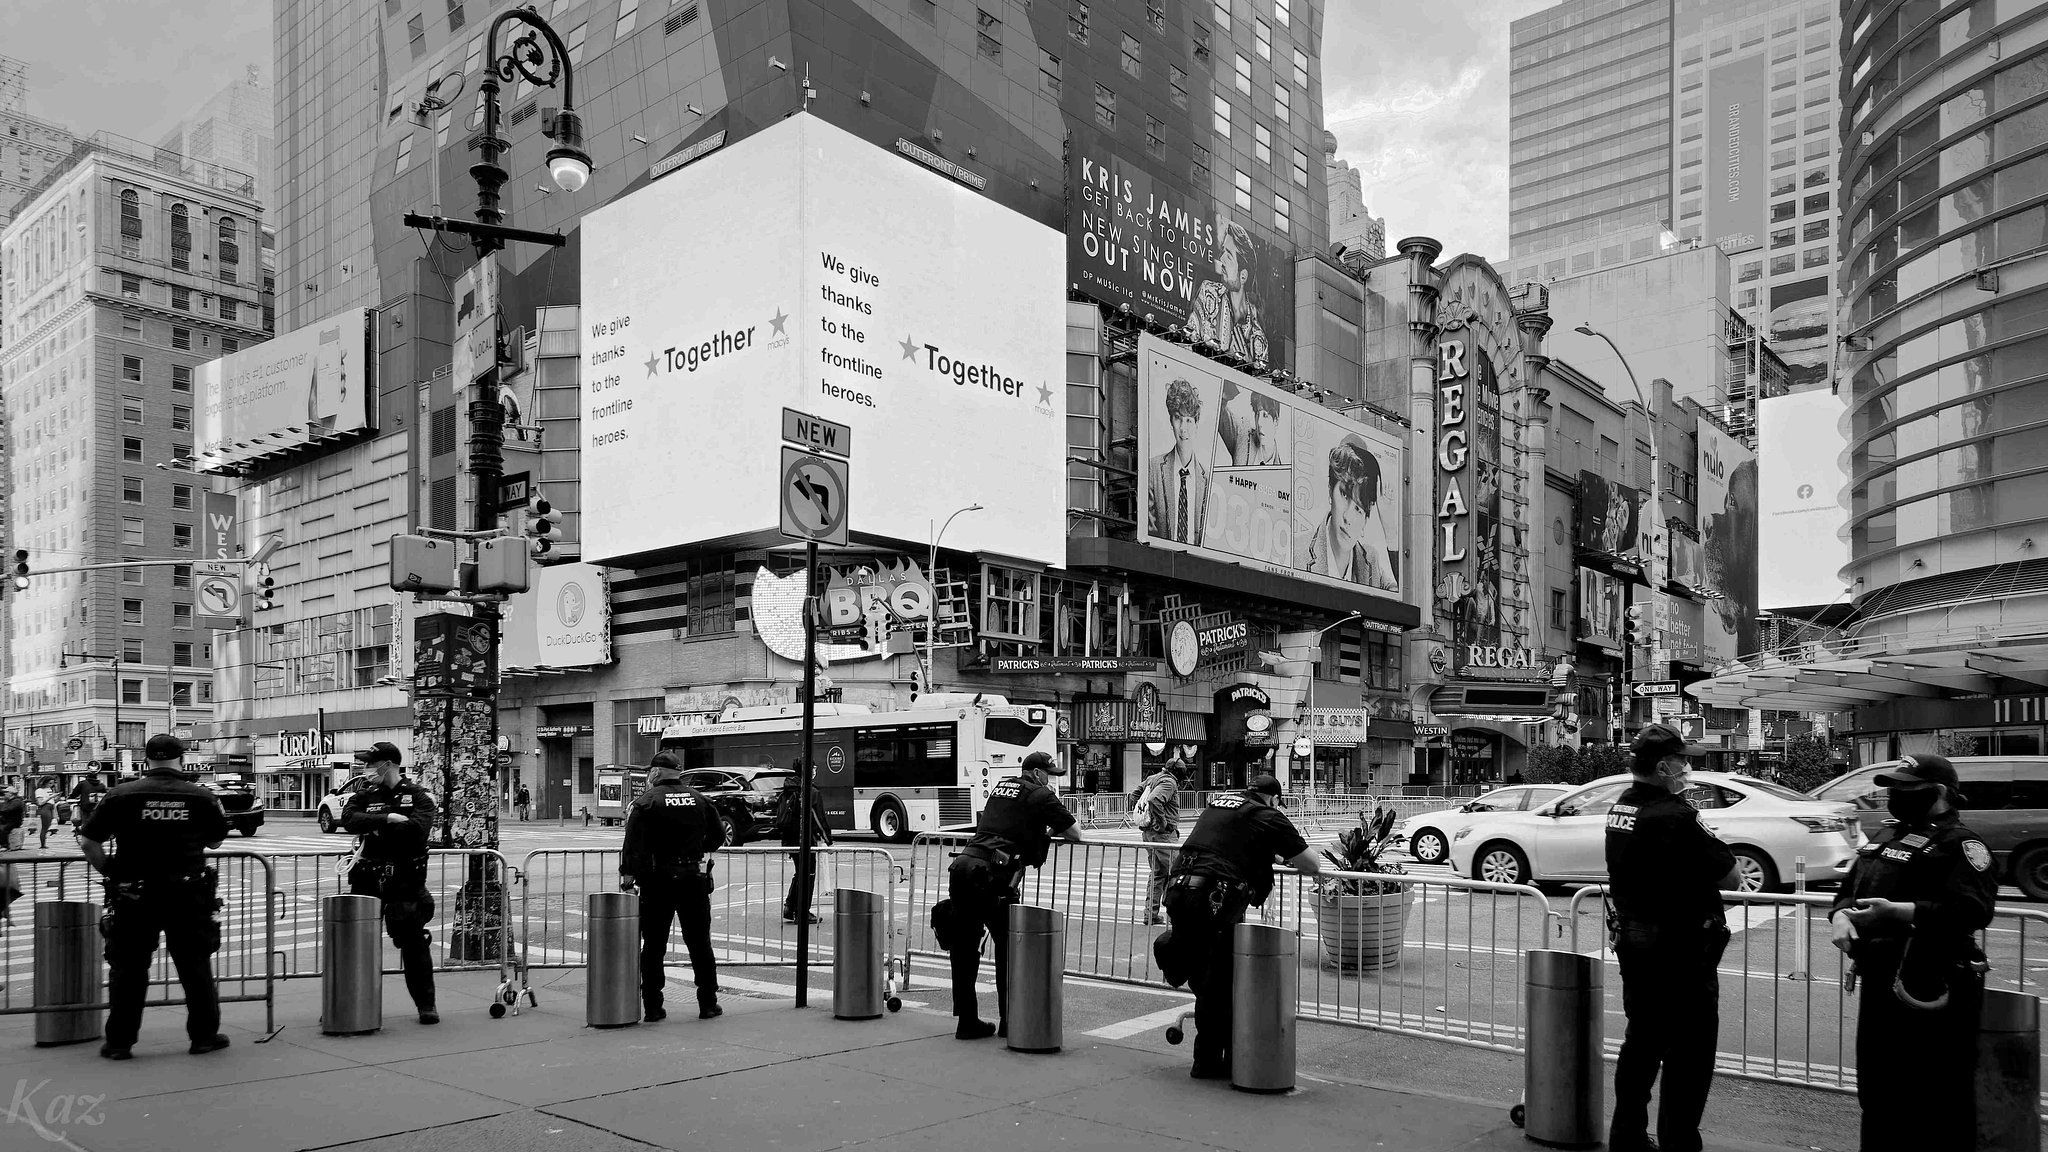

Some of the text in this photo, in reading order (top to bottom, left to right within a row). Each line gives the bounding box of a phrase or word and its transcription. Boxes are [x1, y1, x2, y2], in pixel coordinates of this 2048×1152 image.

[651, 134, 723, 177] OUTFRONT PRIME
[1728, 103, 1741, 202] BRANDEDCITIES.COM
[901, 141, 984, 190] OUTFRONT PRIME
[1082, 157, 1213, 246] KRIS JAMES
[1082, 186, 1213, 264] GET BACK TO LOVE
[1082, 210, 1194, 280] NEW SINGLE
[821, 251, 880, 287] We give
[1083, 231, 1193, 301] OUT NOW
[1083, 270, 1093, 280] DP
[821, 284, 873, 315] thanks
[592, 315, 631, 338] We give
[821, 316, 865, 343] to the
[476, 336, 492, 359] LOCAL
[592, 344, 625, 366] thanks
[664, 326, 755, 373] Together
[205, 382, 220, 397] The
[252, 368, 264, 381] #1
[265, 352, 308, 377] customer
[821, 348, 883, 380] frontline
[924, 343, 1024, 398] Together
[592, 374, 621, 393] to the
[822, 378, 876, 408] heroes.
[204, 380, 289, 417] experience platform.
[592, 398, 633, 421] frontline
[593, 429, 629, 447] heroes.
[797, 418, 836, 447] NEW
[1439, 340, 1469, 563] REGAL
[1704, 450, 1724, 479] nulo
[1277, 490, 1290, 502] DAY
[207, 563, 227, 572] NEW
[846, 572, 907, 586] DALLAS
[1670, 602, 1679, 615] no
[1199, 622, 1247, 647] PATRICK'S
[1366, 621, 1388, 632] OUTFRONT
[1670, 620, 1691, 637] better
[546, 633, 597, 647] DuckDuckGo
[998, 660, 1040, 670] PATRICK'S
[1081, 659, 1118, 669] PATRICK'S
[1468, 645, 1541, 669] REGAL
[1231, 687, 1267, 704] PATRICK'S
[1329, 714, 1363, 727] GUYS
[2020, 697, 2048, 721] TI
[637, 717, 662, 733] PIZZA
[1414, 726, 1448, 735] WESTIN
[665, 798, 697, 807] POLICE
[991, 787, 1020, 798] POLICE
[142, 809, 189, 821] POLICE
[1881, 847, 1912, 862] POLICE
